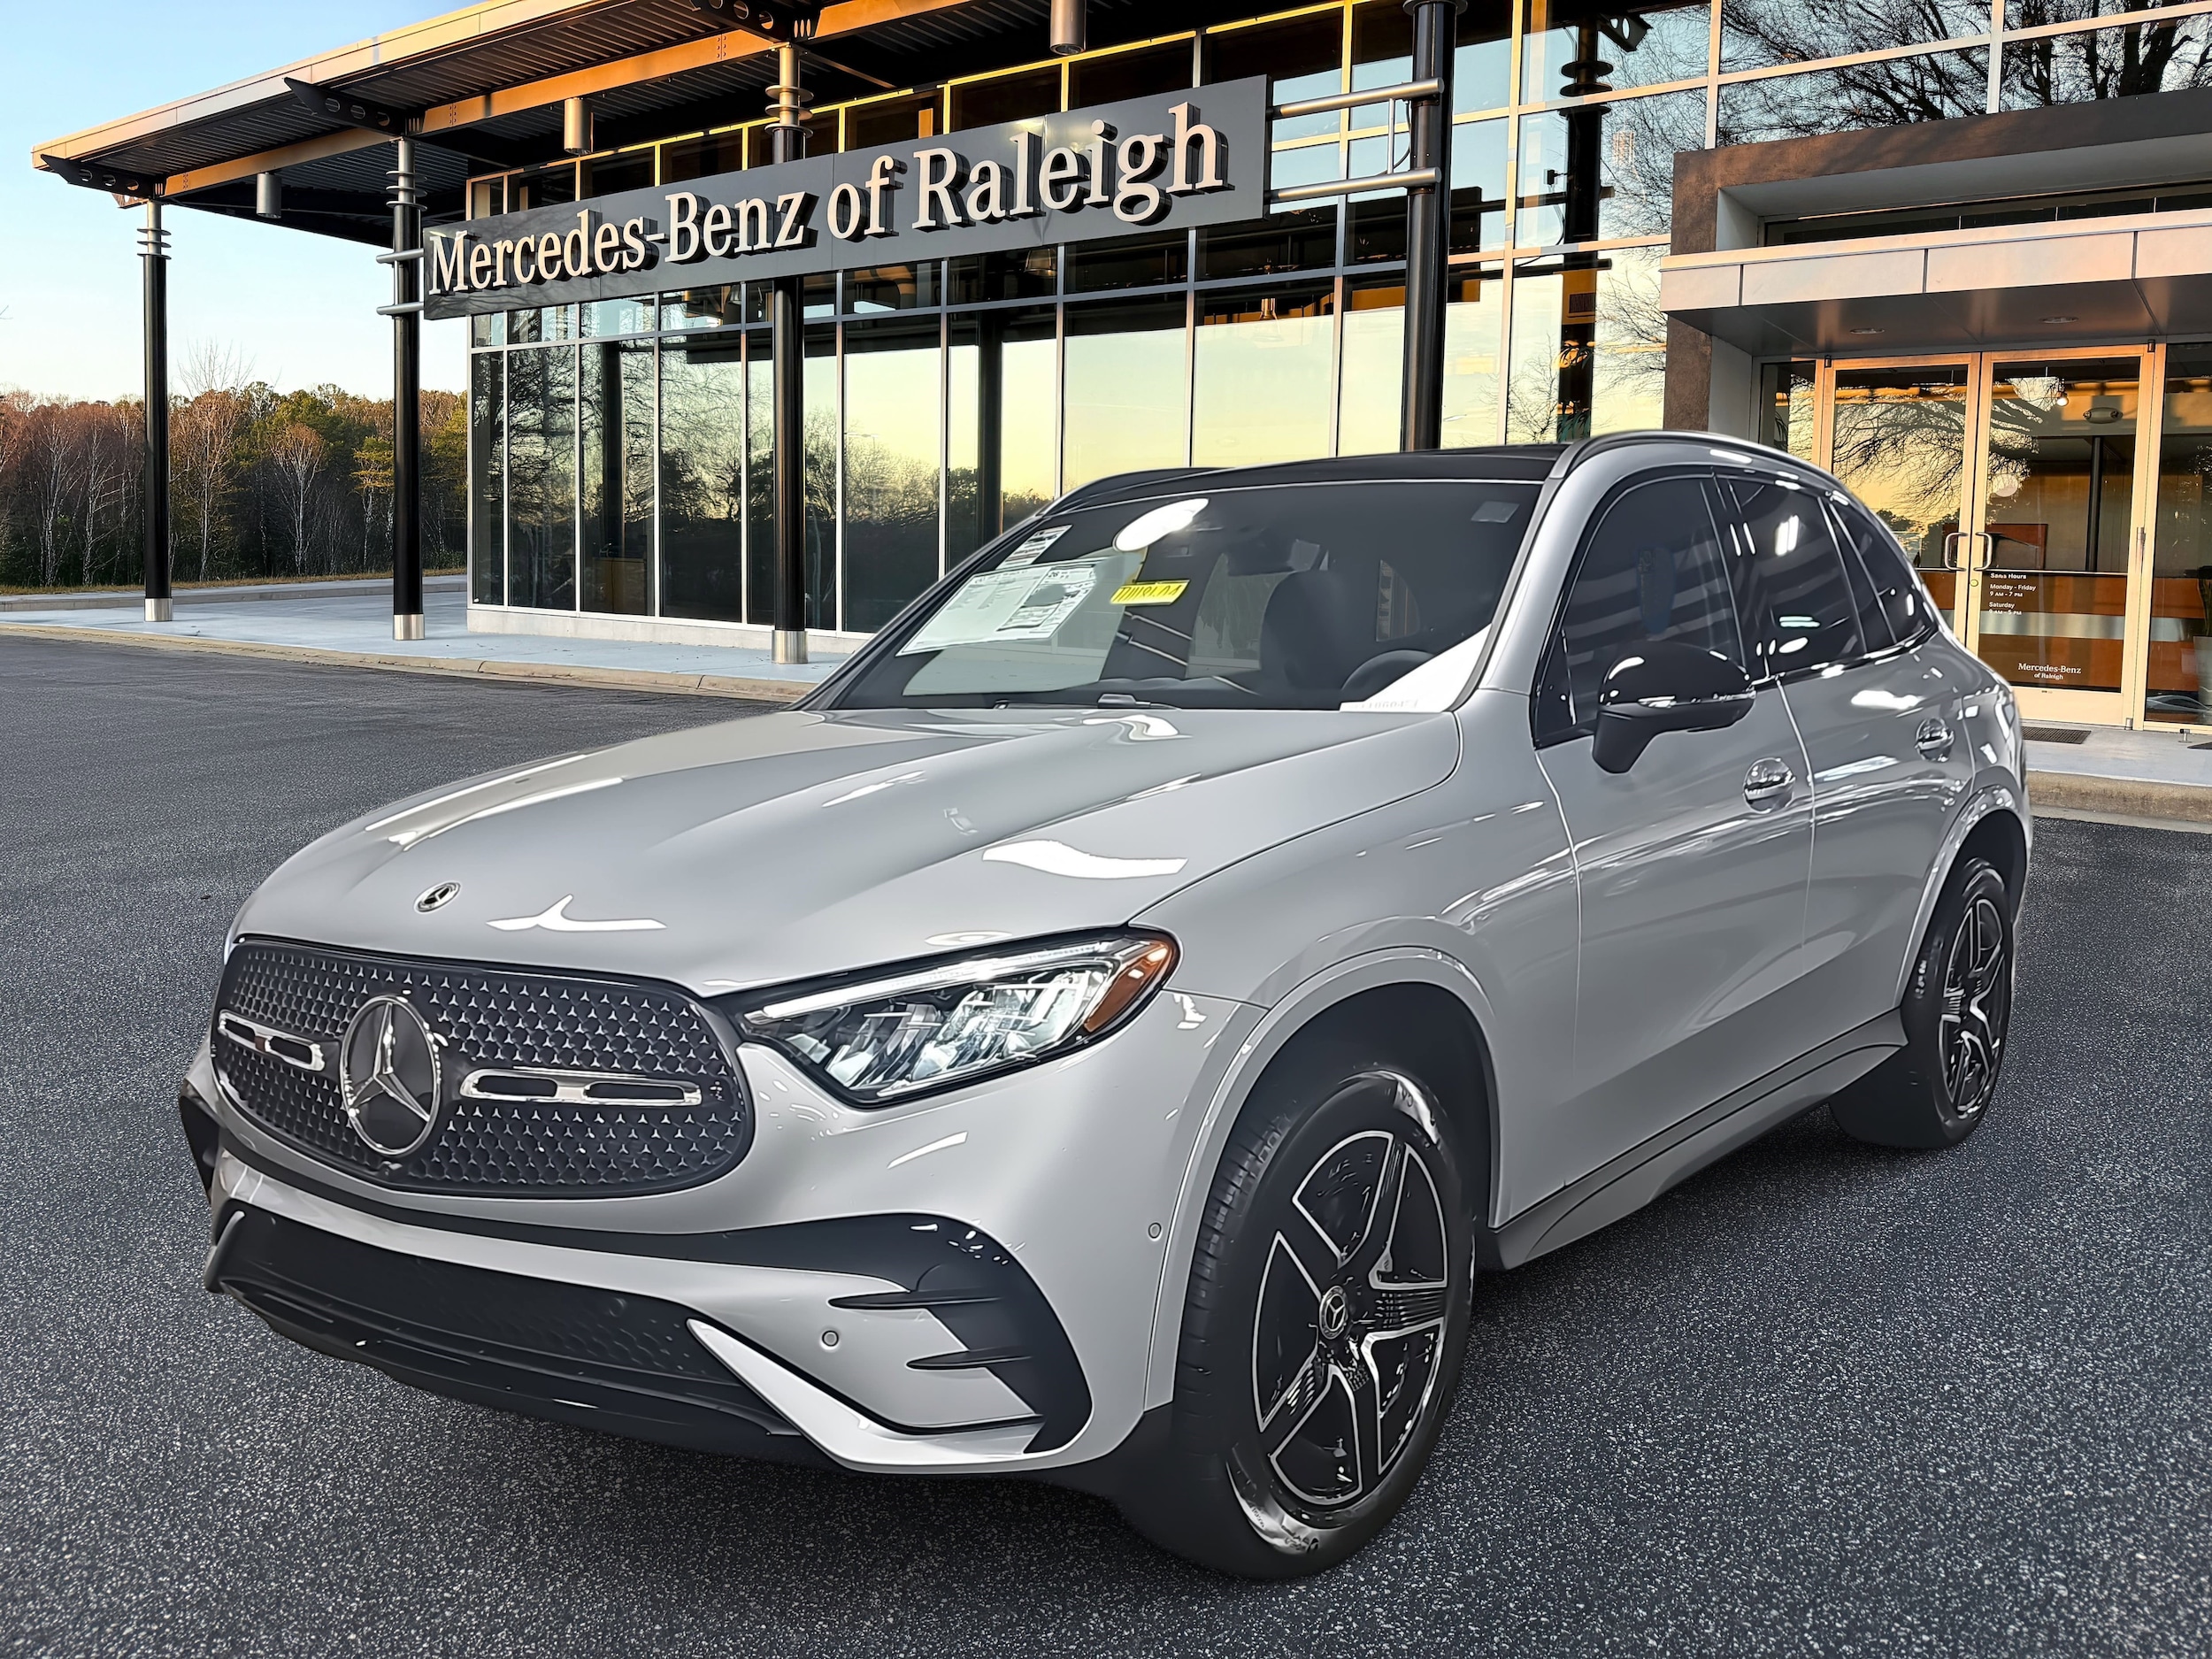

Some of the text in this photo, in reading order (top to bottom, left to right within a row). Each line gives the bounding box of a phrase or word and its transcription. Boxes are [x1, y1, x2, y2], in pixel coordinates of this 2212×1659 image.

[428, 101, 1228, 296] Mercedes-Benz of Raleigh
[2017, 663, 2082, 674] Mercedes-Benz
